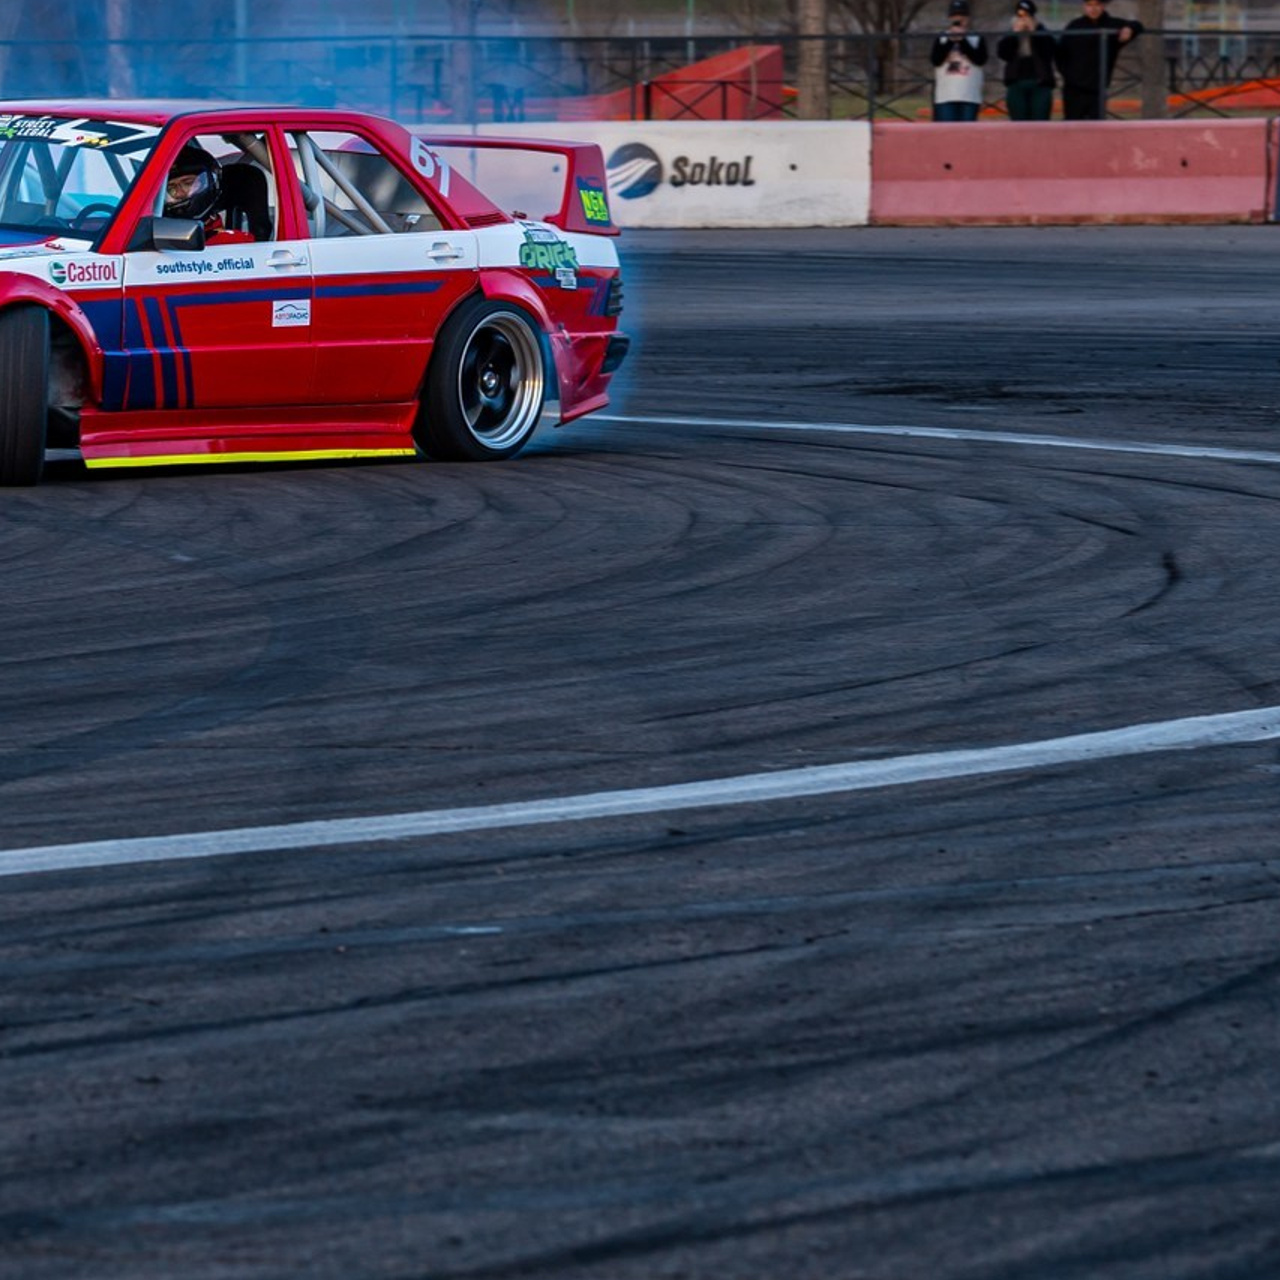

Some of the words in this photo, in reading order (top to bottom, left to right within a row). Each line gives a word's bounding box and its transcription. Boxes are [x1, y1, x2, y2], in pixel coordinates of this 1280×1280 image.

[16, 128, 52, 137] LEGAL
[411, 135, 450, 198] 61
[67, 261, 118, 283] Castrol
[156, 258, 255, 275] southstyle_official
